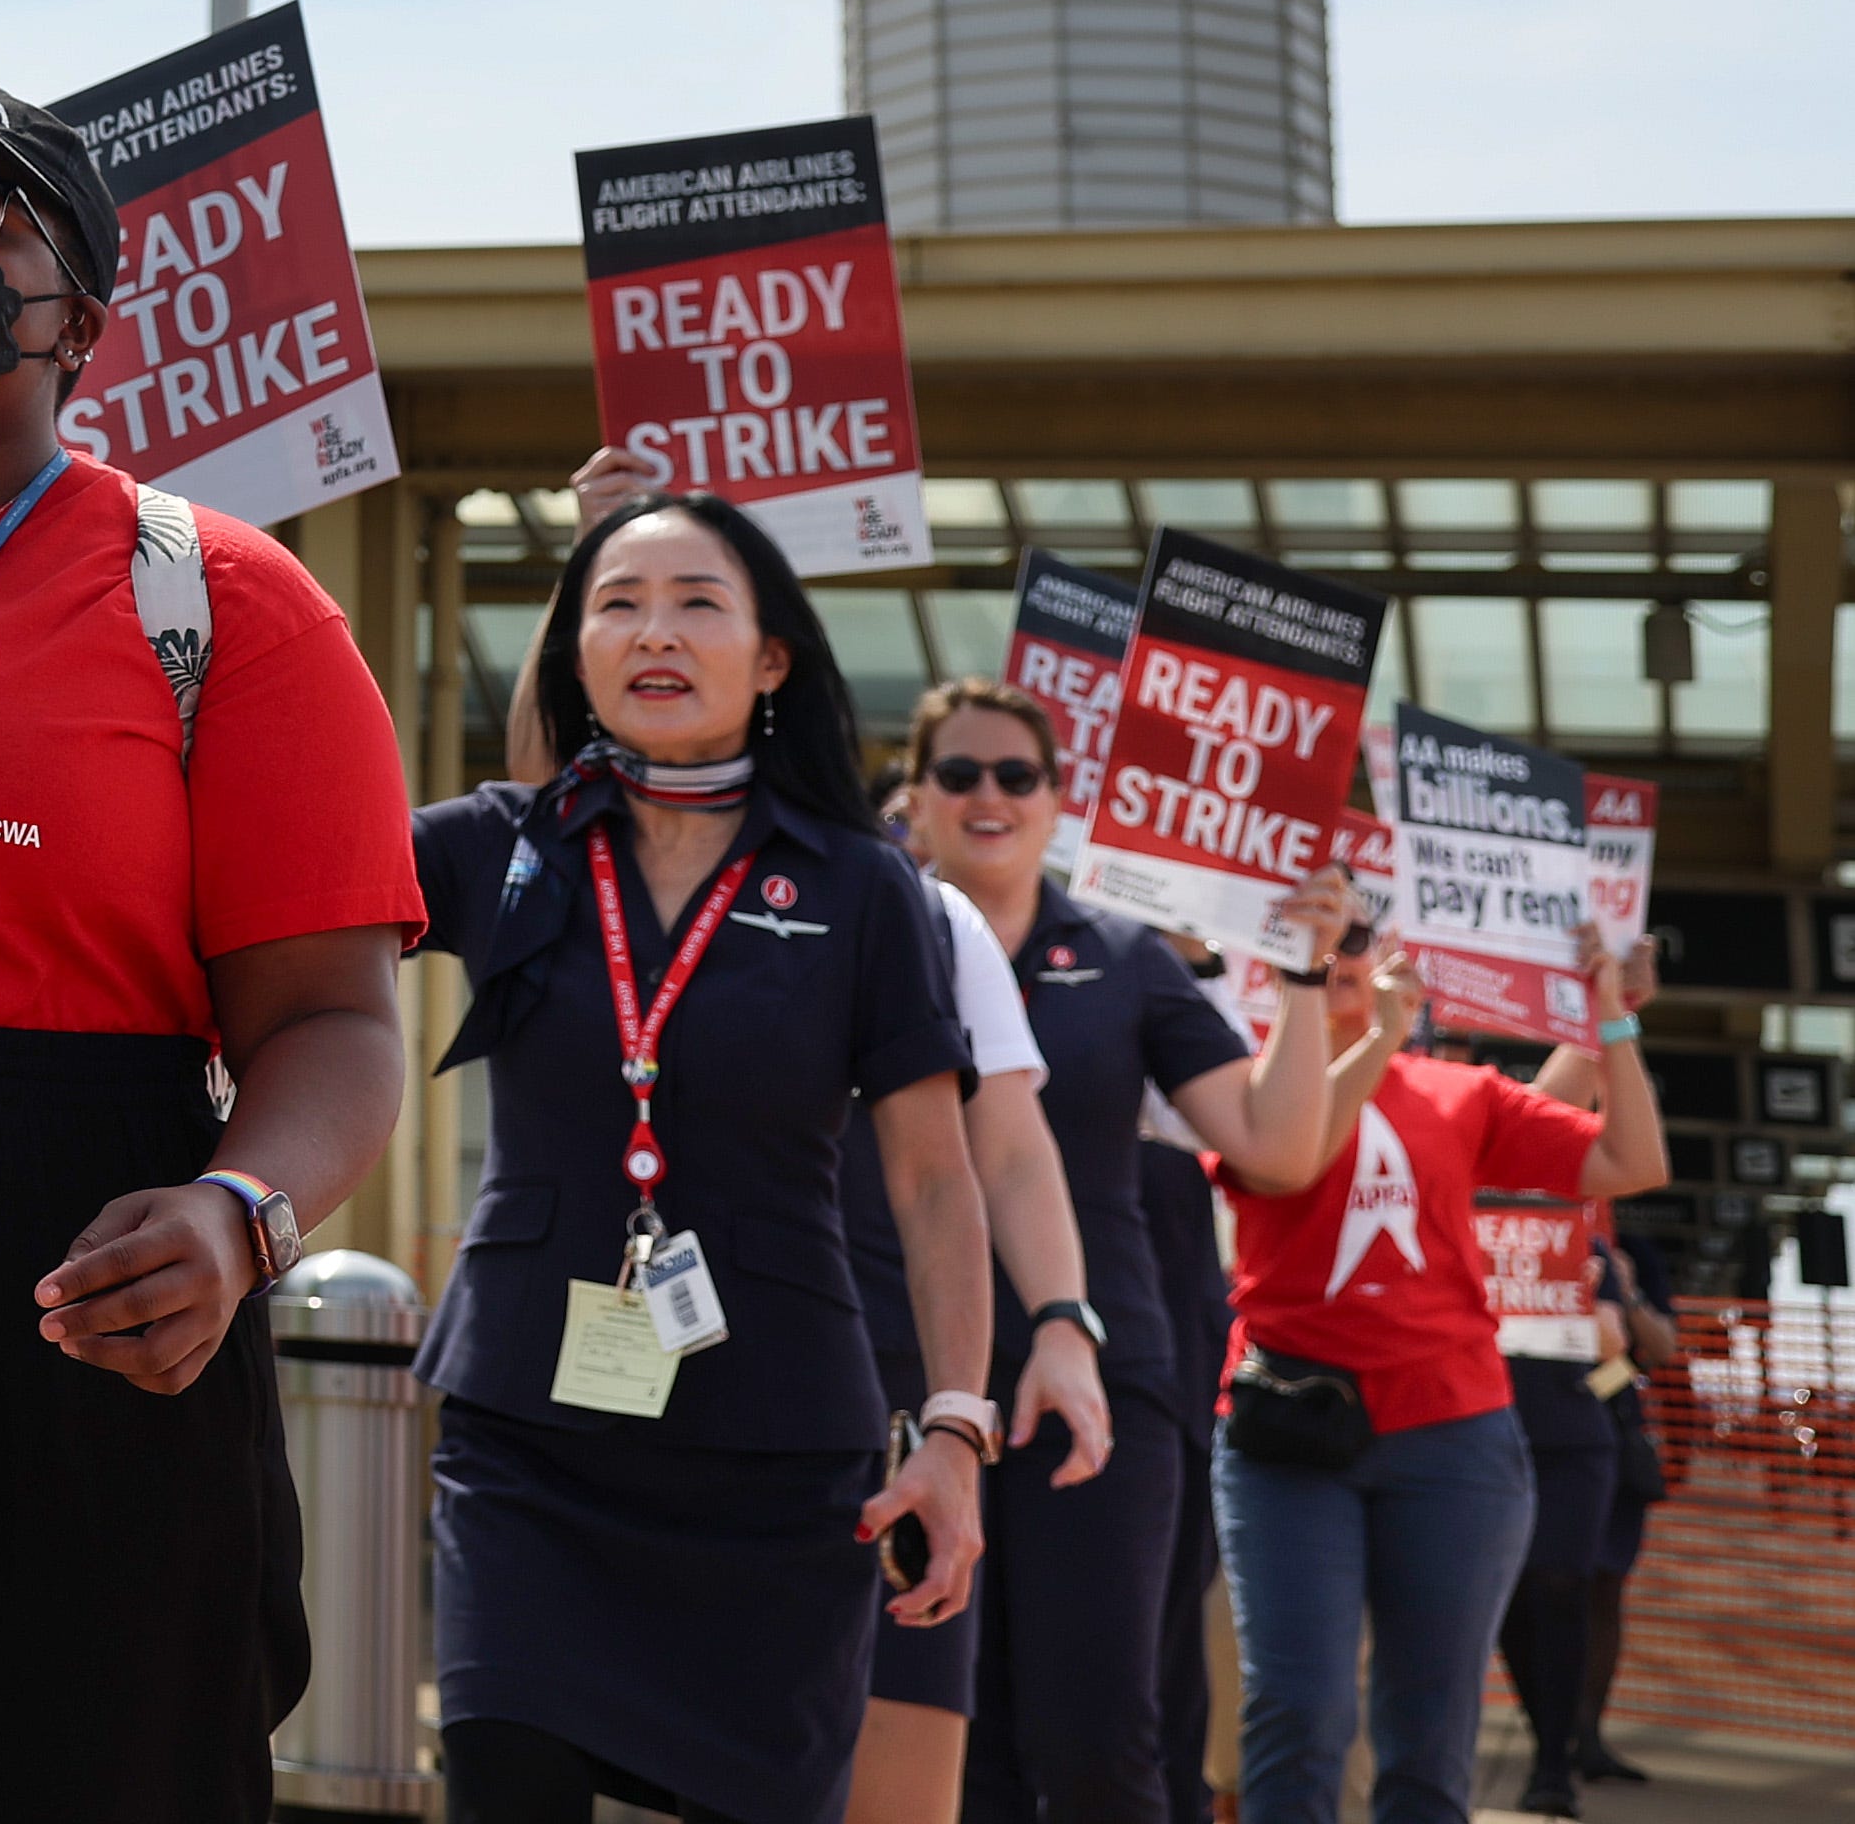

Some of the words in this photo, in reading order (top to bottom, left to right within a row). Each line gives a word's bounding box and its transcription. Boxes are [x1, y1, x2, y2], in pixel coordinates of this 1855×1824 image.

[110, 72, 299, 169] ATTENDANTS:
[162, 44, 286, 123] AIRLINES
[593, 198, 683, 234] FLIGHT
[687, 178, 868, 223] ATTENDANTS:
[597, 163, 734, 206] AMERICAN
[737, 149, 856, 189] AIRLINES
[118, 271, 232, 370] TO
[611, 261, 855, 355] READY
[57, 300, 351, 465] STRIKE
[688, 340, 794, 414] TO
[624, 397, 896, 492] STRIKE
[1153, 576, 1229, 621] FLIGHT
[1164, 557, 1275, 609] AMERICAN
[1272, 591, 1368, 642] AIRLINES
[1137, 647, 1336, 760] READY
[1184, 725, 1264, 801] TO
[1400, 732, 1438, 767] AA
[1442, 741, 1531, 782] makes
[1107, 766, 1321, 878] STRIKE
[1406, 767, 1585, 846] billions.
[1591, 788, 1642, 824] AA
[1411, 833, 1455, 868] We
[1464, 848, 1531, 881] can't
[1417, 876, 1488, 928] pay
[1349, 1182, 1419, 1210] APFA
[1490, 1243, 1542, 1280] TO
